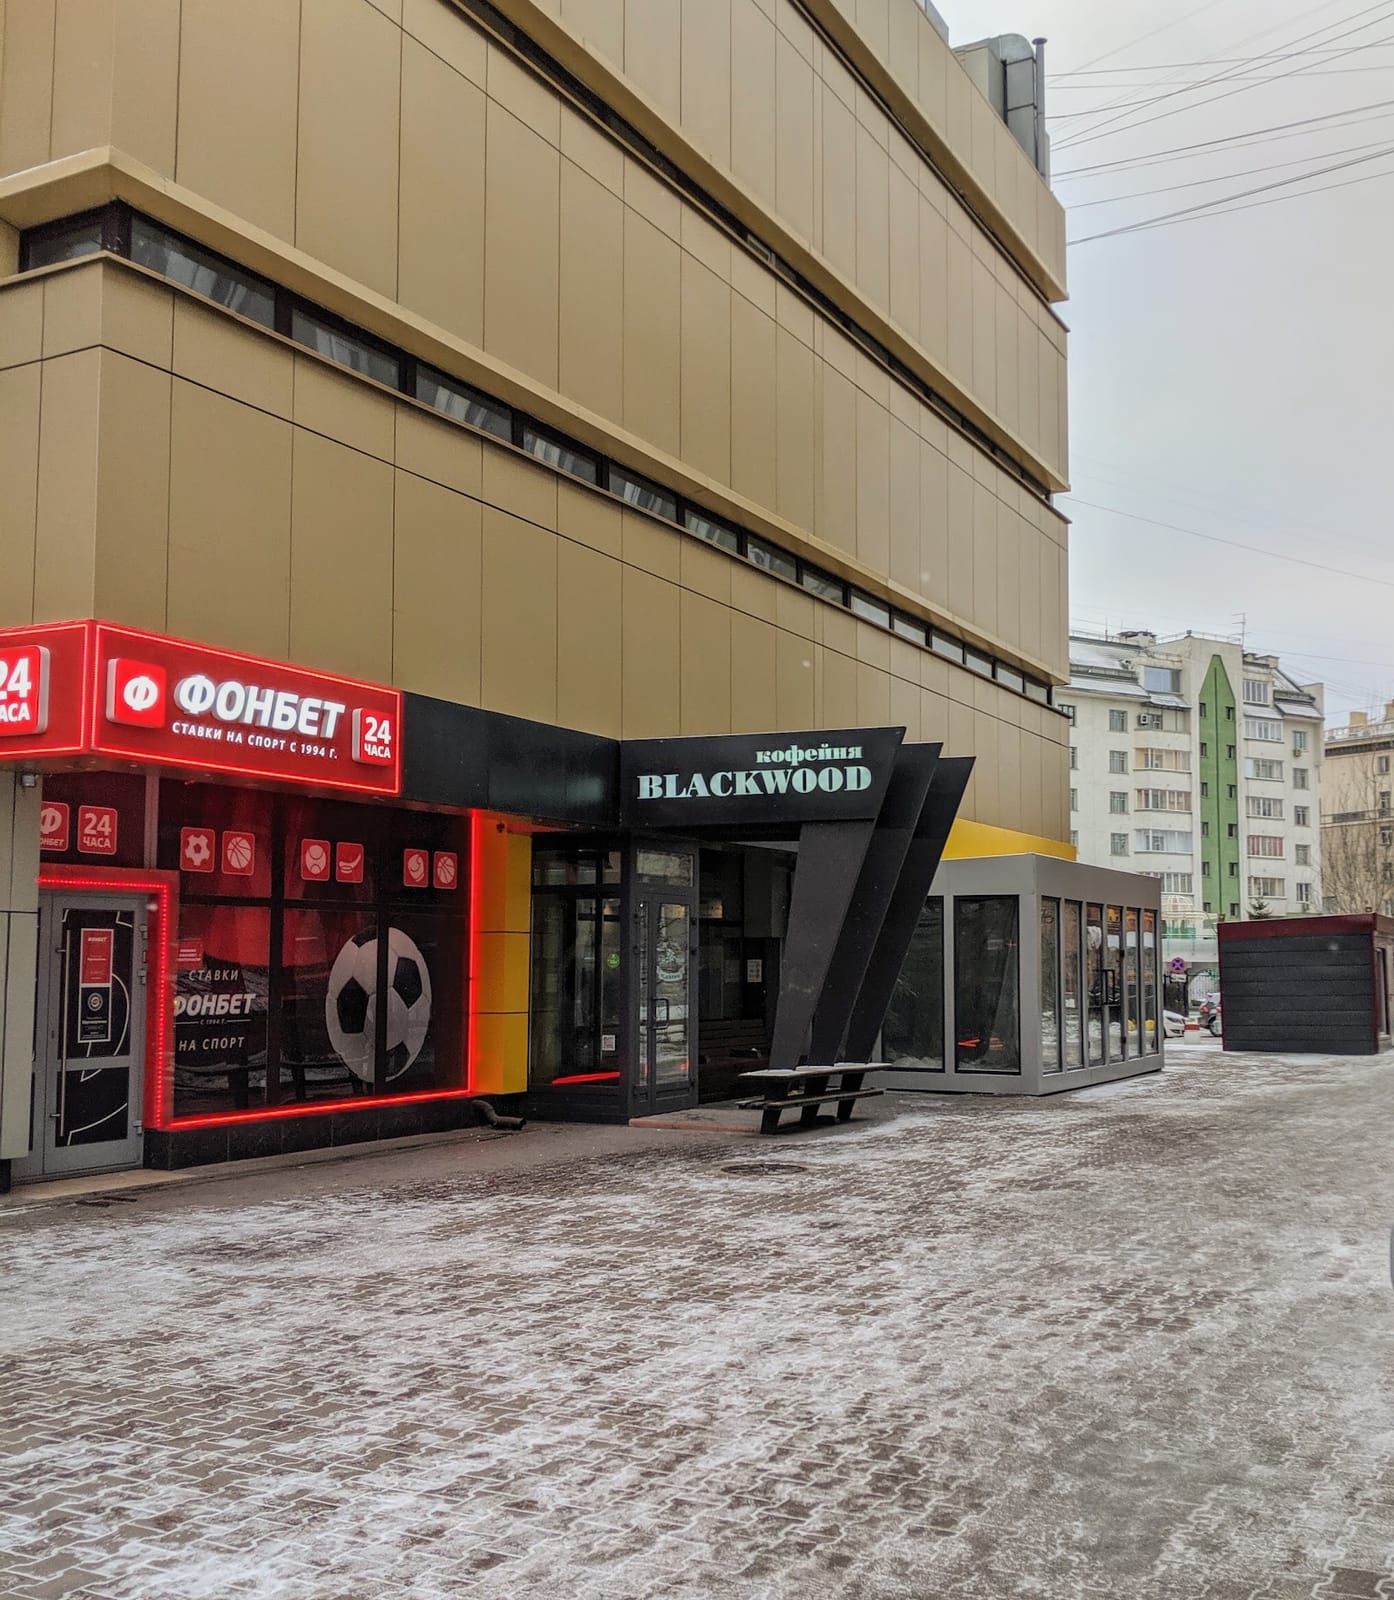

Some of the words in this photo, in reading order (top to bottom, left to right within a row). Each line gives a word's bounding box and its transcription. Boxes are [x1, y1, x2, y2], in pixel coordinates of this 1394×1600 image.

[0, 702, 31, 722] АСА
[175, 674, 346, 739] ФОНБЕТ
[172, 722, 222, 740] СТАВКИ
[226, 731, 243, 744] НА
[248, 735, 285, 751] СПОРТ
[290, 742, 297, 752] С
[301, 744, 326, 756] 1994
[364, 717, 392, 744] 24
[364, 743, 392, 759] ЧАСА
[756, 743, 864, 766] кофейня
[637, 766, 872, 800] BLACKWOOD
[83, 812, 112, 836] 24
[83, 836, 111, 848] ЧАСА
[188, 970, 239, 981] СТАВКИ
[178, 1039, 196, 1052] НА
[202, 1036, 245, 1050] СПОРТ
